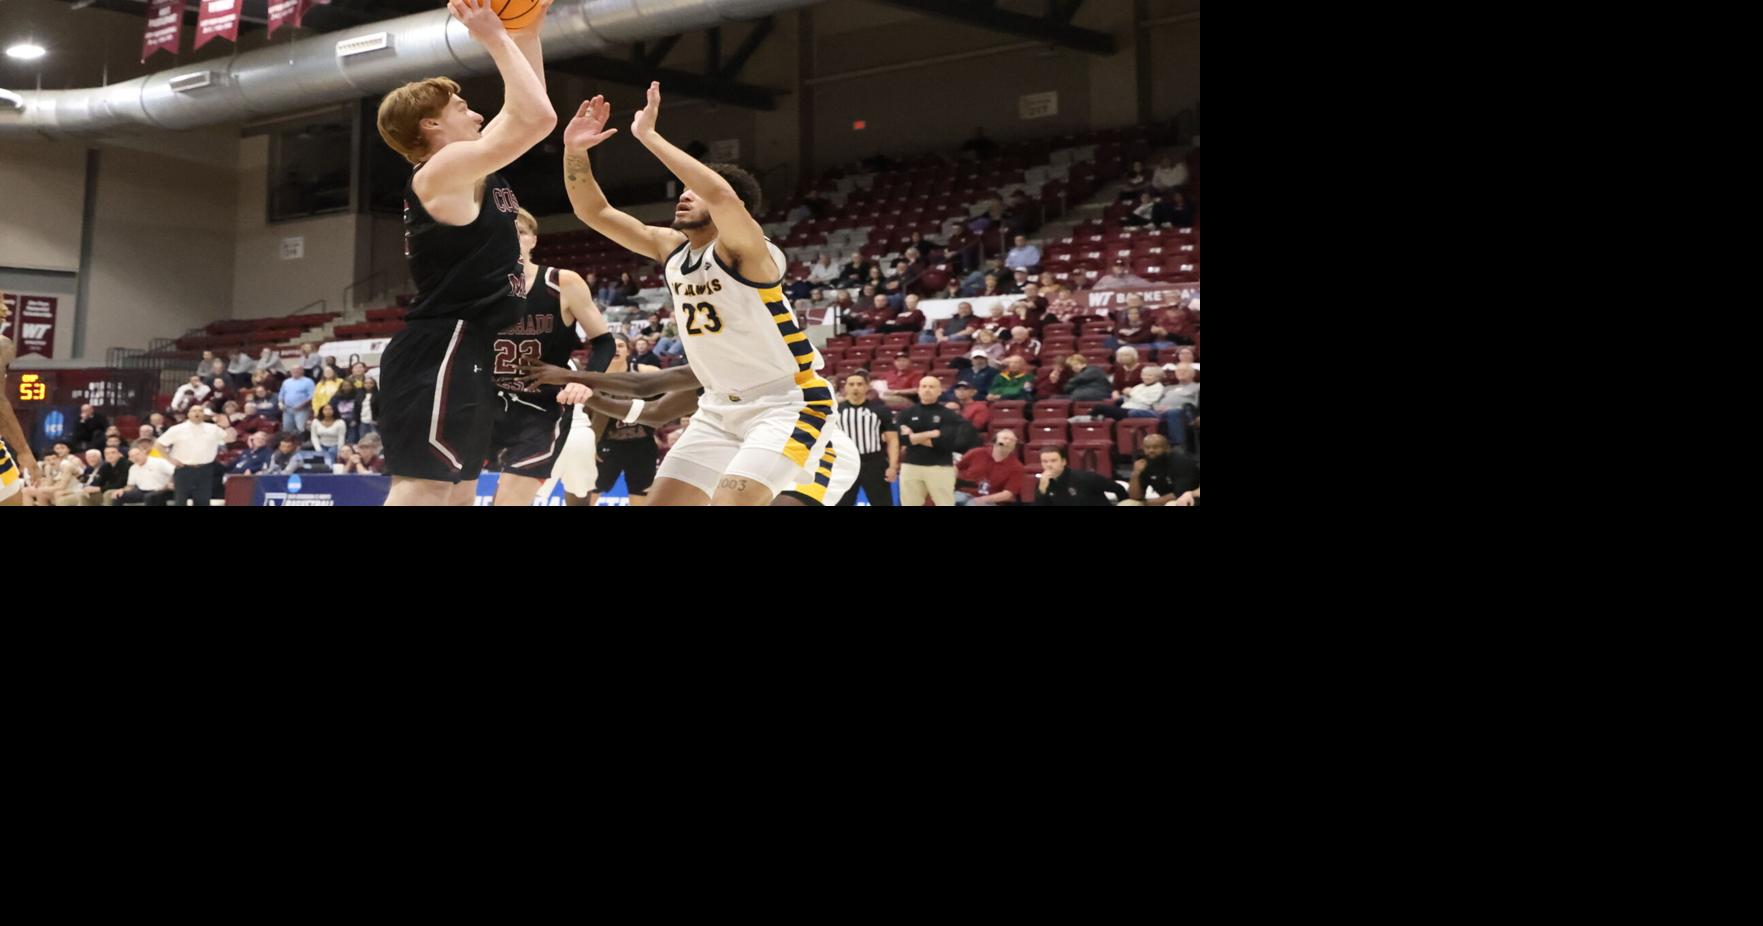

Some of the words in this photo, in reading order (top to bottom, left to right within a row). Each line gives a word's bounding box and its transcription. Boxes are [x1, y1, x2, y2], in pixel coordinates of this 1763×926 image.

[1088, 291, 1115, 307] WT
[682, 301, 722, 335] 23
[22, 323, 52, 340] WT
[19, 383, 46, 401] 53
